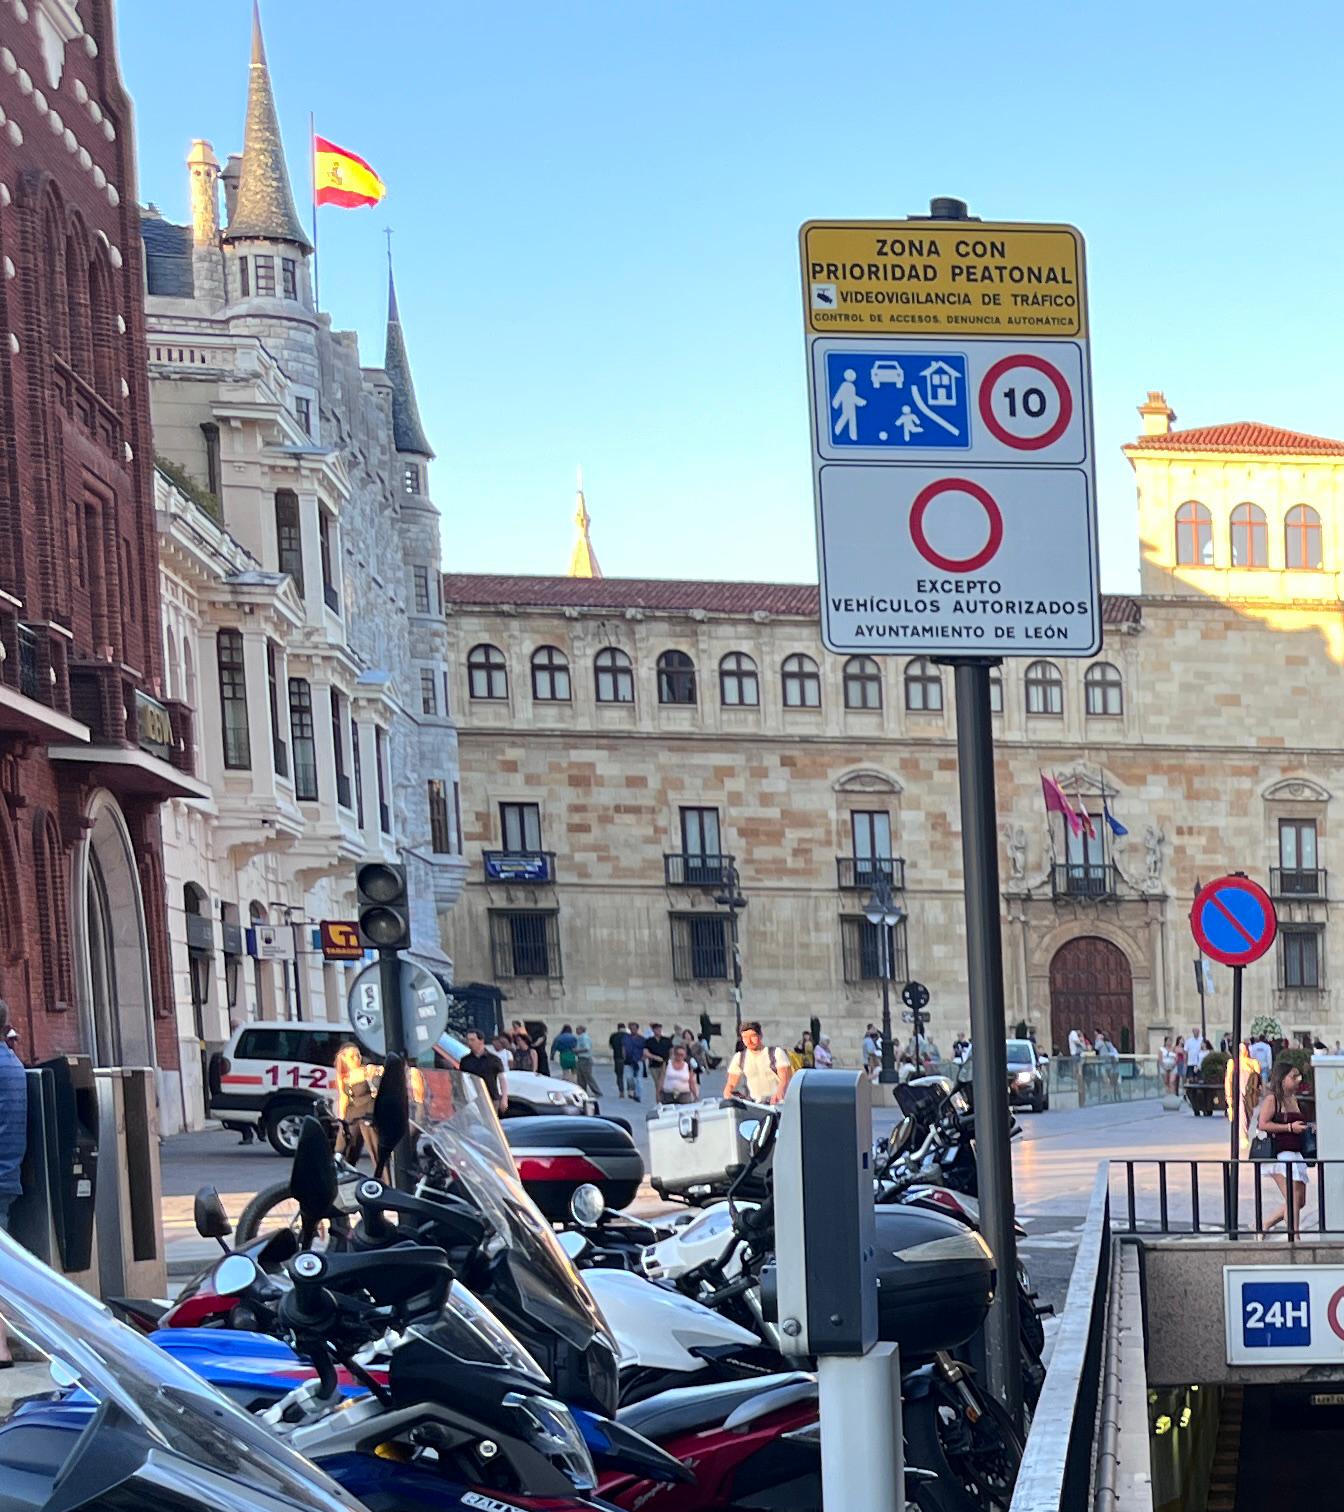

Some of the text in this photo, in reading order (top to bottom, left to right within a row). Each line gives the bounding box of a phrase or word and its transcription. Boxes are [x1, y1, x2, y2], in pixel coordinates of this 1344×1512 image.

[876, 239, 1006, 259] ZONA CON
[811, 262, 1073, 285] PRIORIDAD PEATONAL
[840, 290, 1076, 308] VIDEOVIGILANCIA DE TRÁFICO
[814, 312, 864, 323] CONTROL
[869, 313, 883, 323] DE
[946, 315, 1001, 326] DENUNCIA
[1007, 314, 1075, 327] AUTOMÁTICA
[1003, 387, 1046, 418] 10
[916, 579, 1002, 594] EXCEPTO
[831, 596, 1089, 615] VEHÍCULOS AUTORIZADOS
[854, 623, 1068, 640] AYUNTAMIENTO DE LEÓN
[265, 1065, 328, 1089] 112
[1246, 1301, 1308, 1329] 24H
